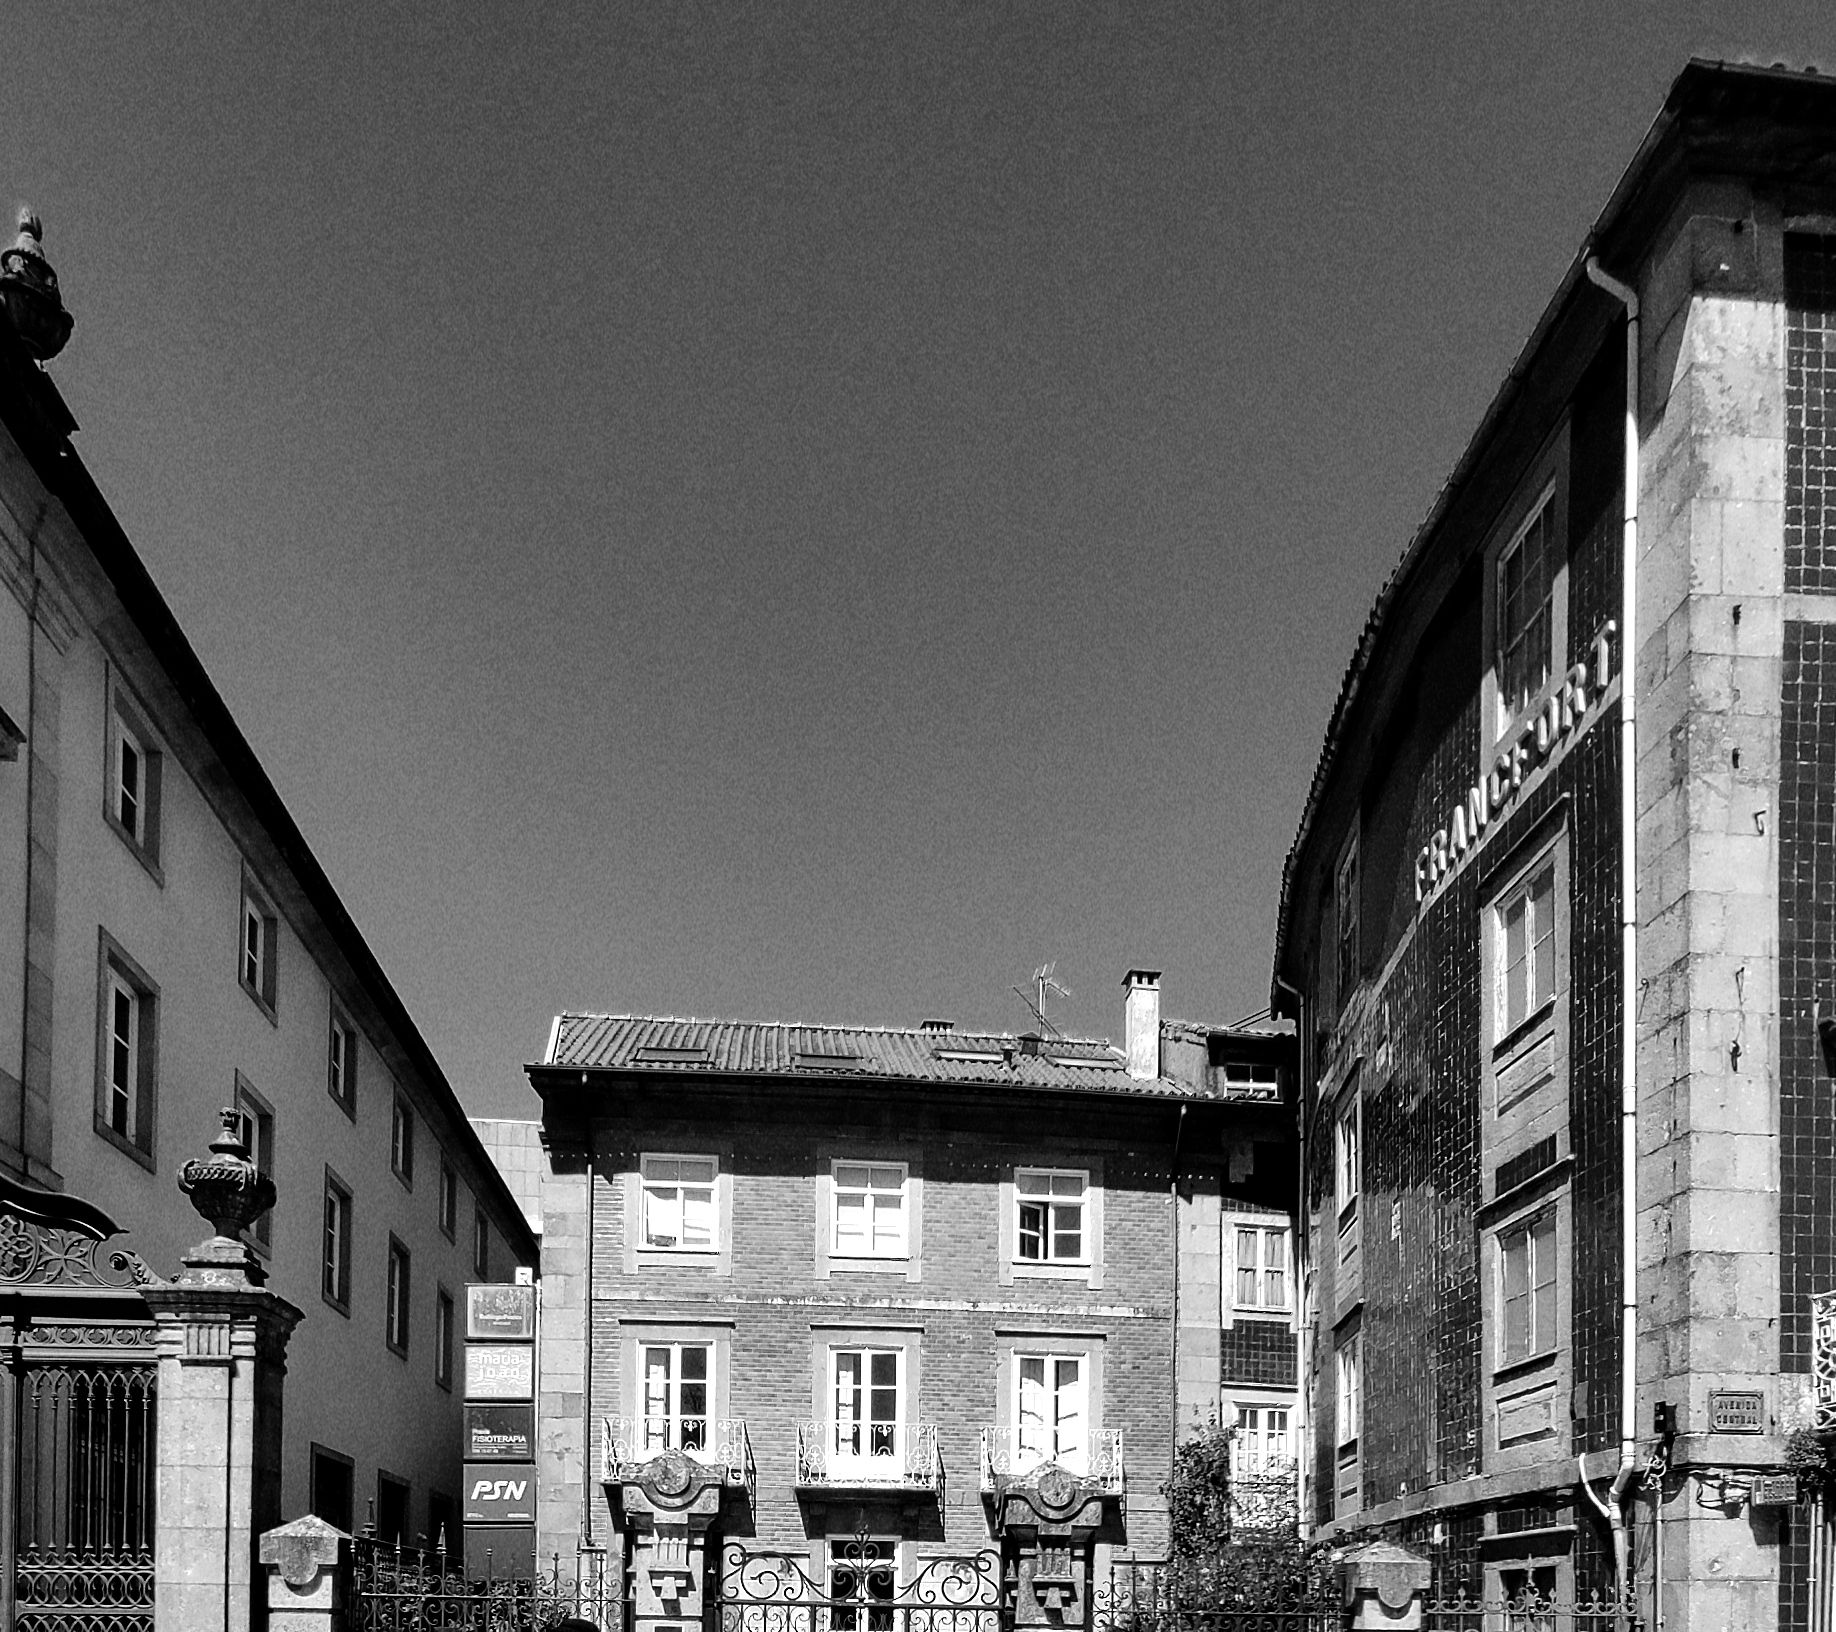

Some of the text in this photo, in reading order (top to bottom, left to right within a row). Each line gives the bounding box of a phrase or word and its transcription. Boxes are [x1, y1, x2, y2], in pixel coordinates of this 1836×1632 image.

[1414, 618, 1617, 902] FRANCFORT
[1718, 1401, 1757, 1410] AVENIDA
[1716, 1415, 1757, 1424] CENTRAL
[472, 1435, 527, 1443] FISIOTERAPIA
[470, 1480, 527, 1501] PSN
